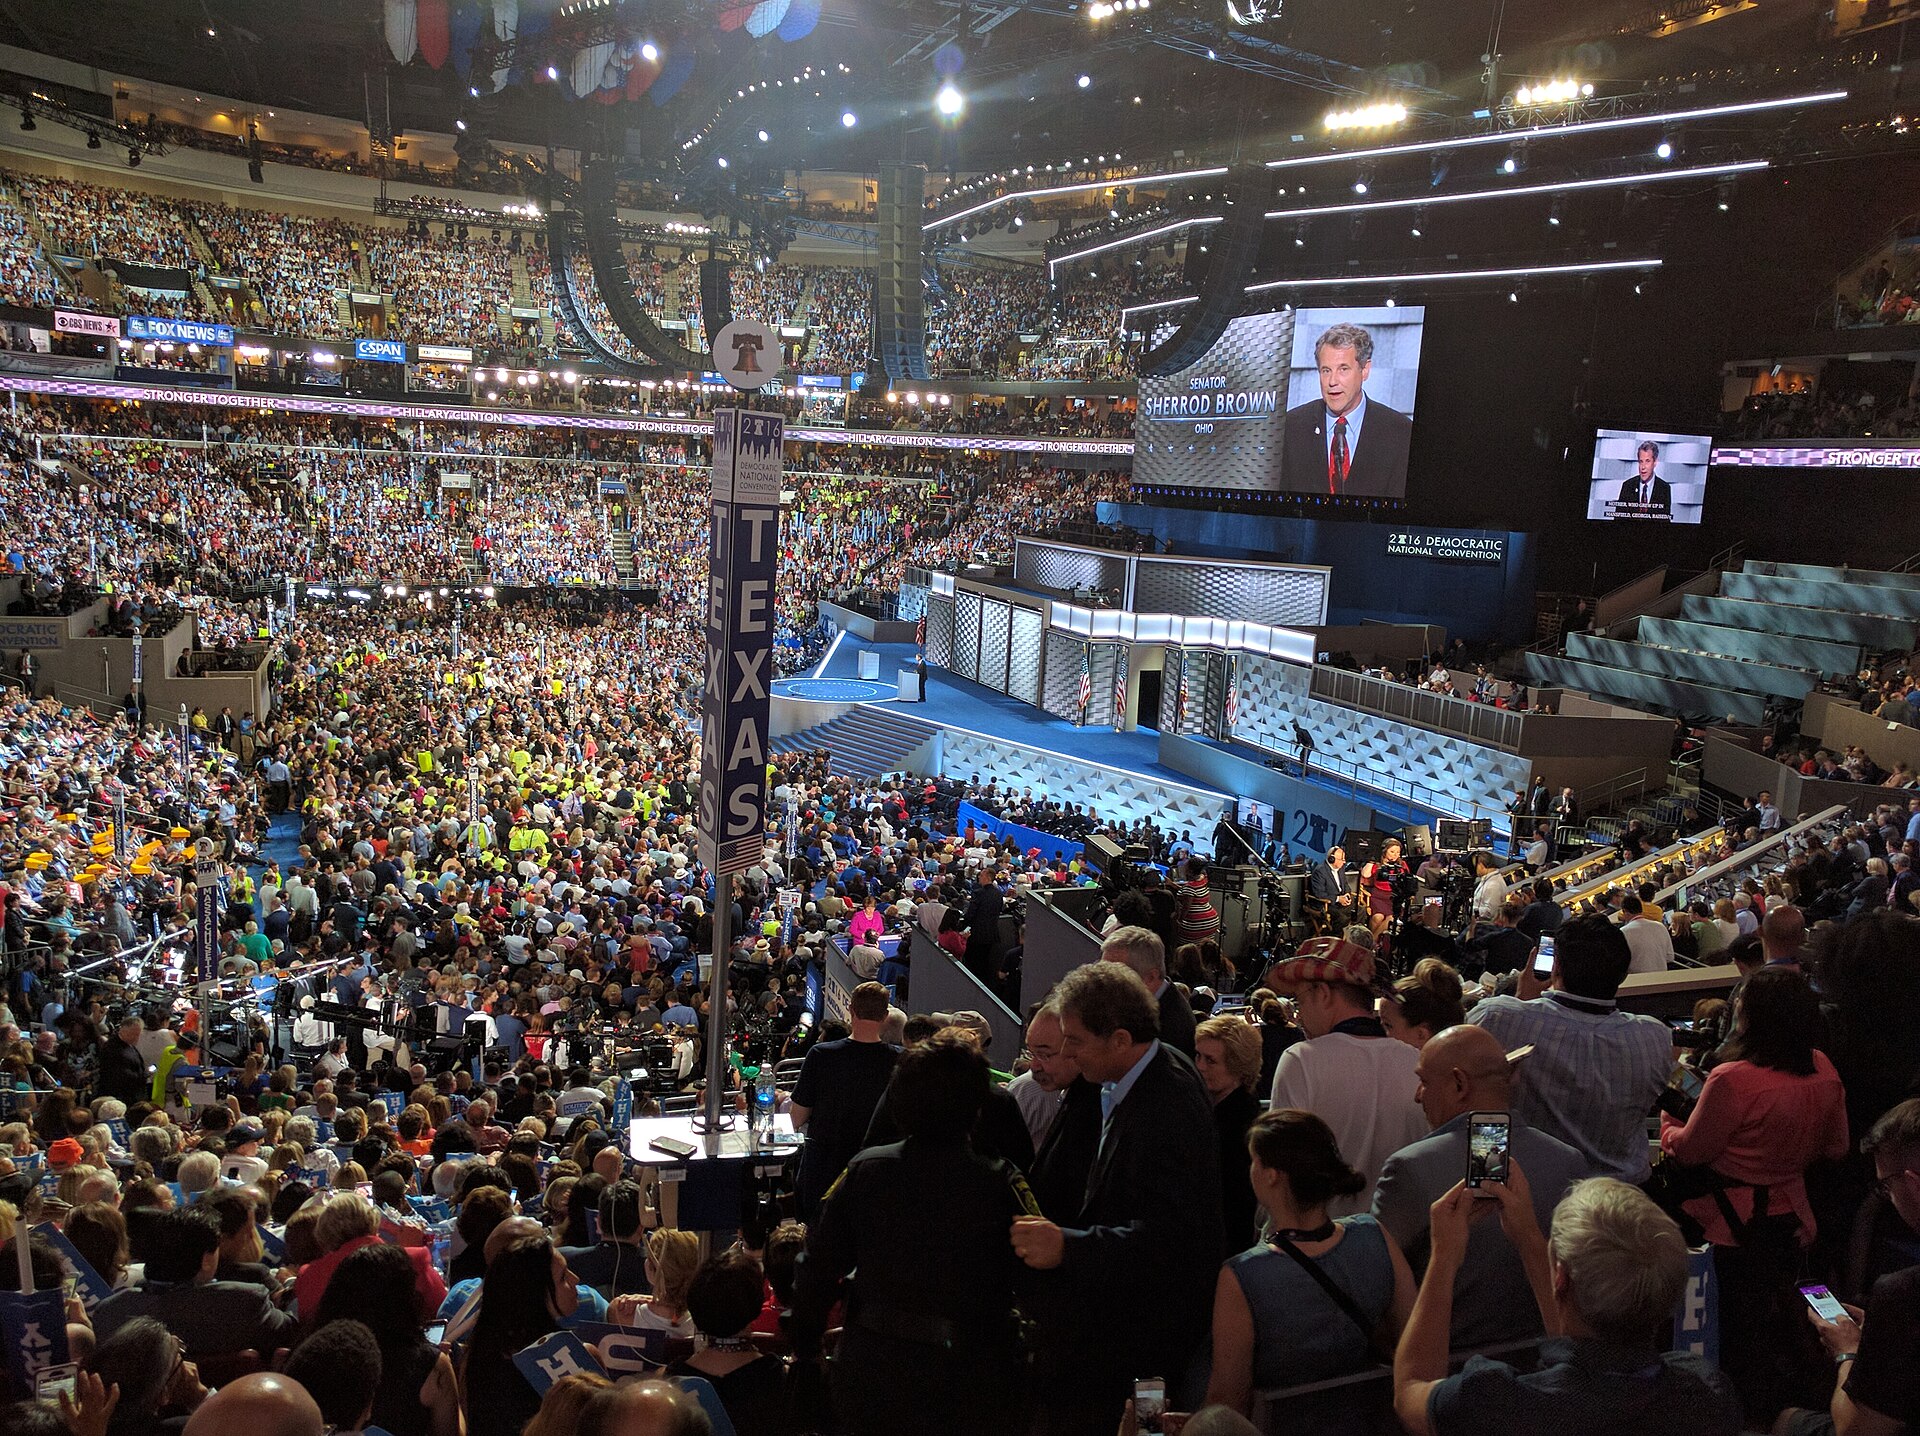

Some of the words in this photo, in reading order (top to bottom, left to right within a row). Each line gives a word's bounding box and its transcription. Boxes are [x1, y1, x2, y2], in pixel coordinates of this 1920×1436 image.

[69, 318, 83, 329] CBS
[84, 320, 102, 331] NEWS
[148, 321, 175, 336] FOX
[177, 325, 215, 340] NEWS
[359, 342, 401, 355] C-SPAN
[1190, 376, 1226, 390] SENATOR
[144, 389, 208, 404] STRONGER
[211, 394, 275, 408] TOGETHER
[1145, 394, 1210, 416] SHERROD
[1215, 391, 1276, 414] BROWN
[403, 407, 449, 420] HILLARY
[450, 410, 502, 423] CLINTON
[627, 421, 683, 432] STRONGER
[686, 424, 714, 435] TOGE
[1195, 423, 1213, 434] OHIO
[849, 432, 888, 444] HILLARY
[889, 435, 933, 446] CLINTON
[1039, 442, 1083, 452] STRONGER
[1084, 443, 1127, 454] TOGETHER
[1827, 452, 1902, 465] STRONGER
[740, 461, 778, 472] DEMOCRATIC
[740, 471, 777, 482] NATIONAL
[740, 481, 777, 491] CONVENTION
[1426, 536, 1503, 551] DEMOCRATIC
[1388, 545, 1433, 556] NATIONAL
[1438, 548, 1501, 560] CONVENTION
[701, 505, 727, 832] TEXAS
[727, 509, 773, 836] TEXAS
[621, 816, 635, 826] USA
[113, 804, 122, 856] WISCONSIN
[70, 883, 80, 902] USA
[783, 907, 791, 944] HILLARY
[203, 888, 213, 981] MASSACHUSETTS
